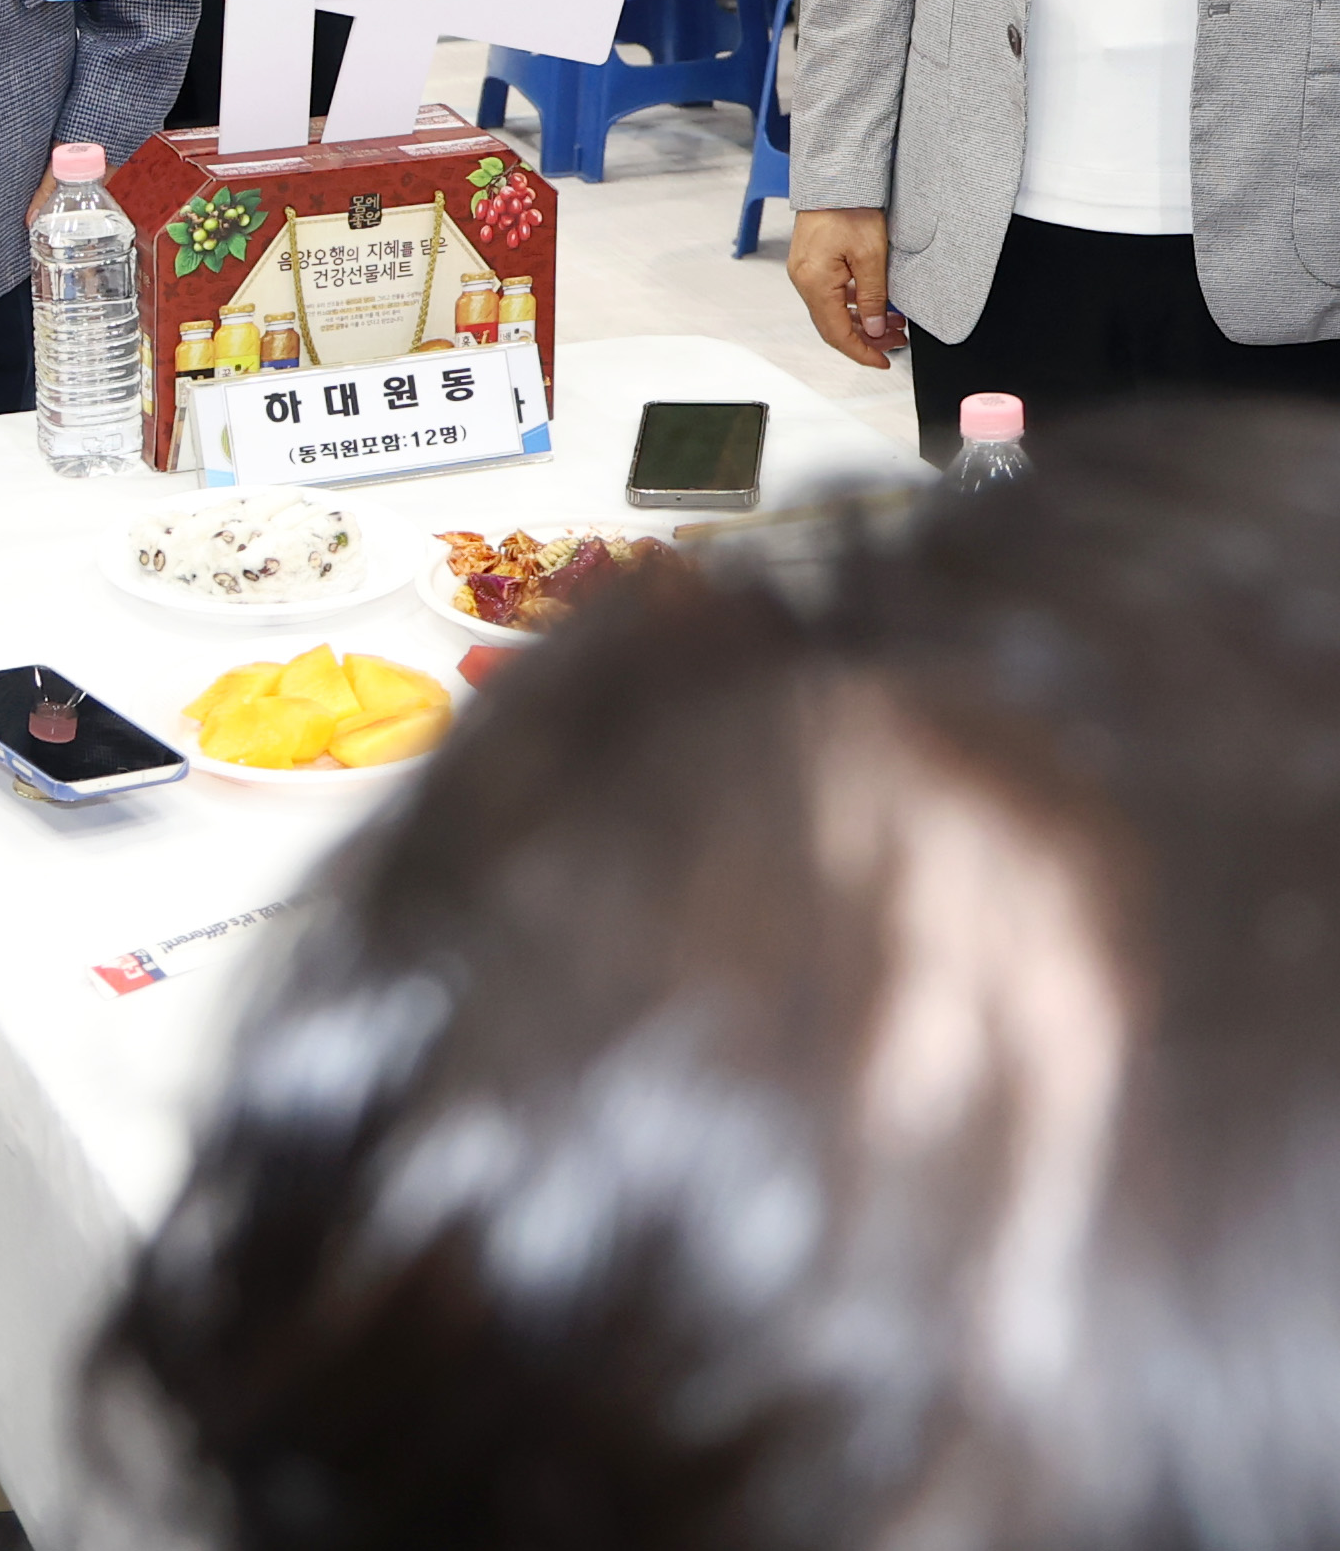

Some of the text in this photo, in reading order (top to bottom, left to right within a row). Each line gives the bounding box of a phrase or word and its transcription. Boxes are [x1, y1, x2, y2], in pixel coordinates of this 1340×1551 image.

[277, 245, 360, 272] 음양오행의
[366, 239, 416, 261] 지혜를
[313, 260, 414, 289] 건강선물세트
[288, 424, 468, 465] (동직원포함:12명)
